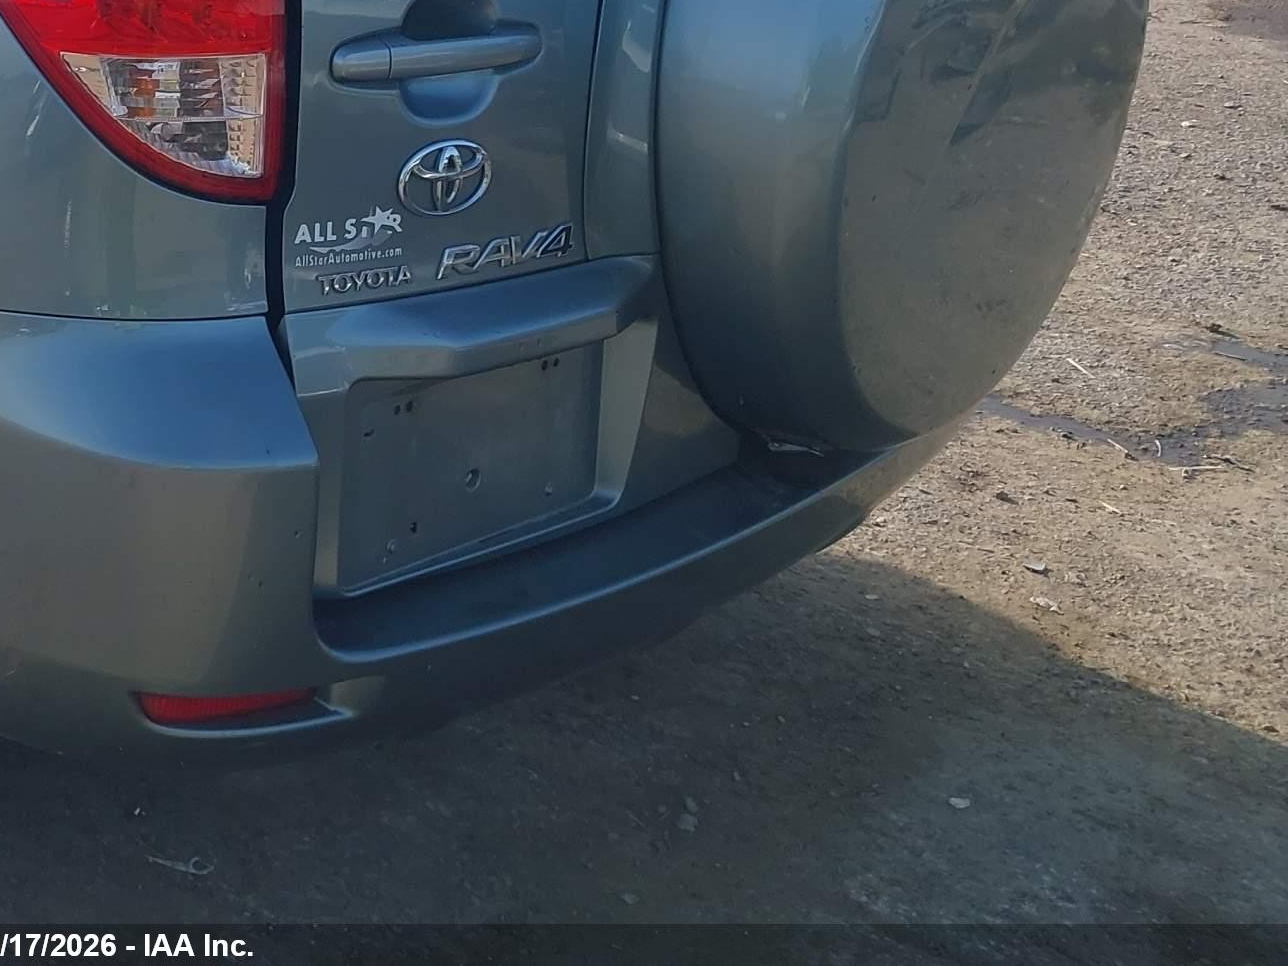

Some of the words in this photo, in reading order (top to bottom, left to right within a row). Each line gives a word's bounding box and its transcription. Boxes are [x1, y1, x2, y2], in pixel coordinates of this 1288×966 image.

[294, 221, 337, 244] ALL
[343, 206, 403, 240] STR
[295, 247, 402, 267] AllStarAutomotive.com
[436, 222, 575, 280] RAV4
[317, 265, 412, 296] TOYOTA
